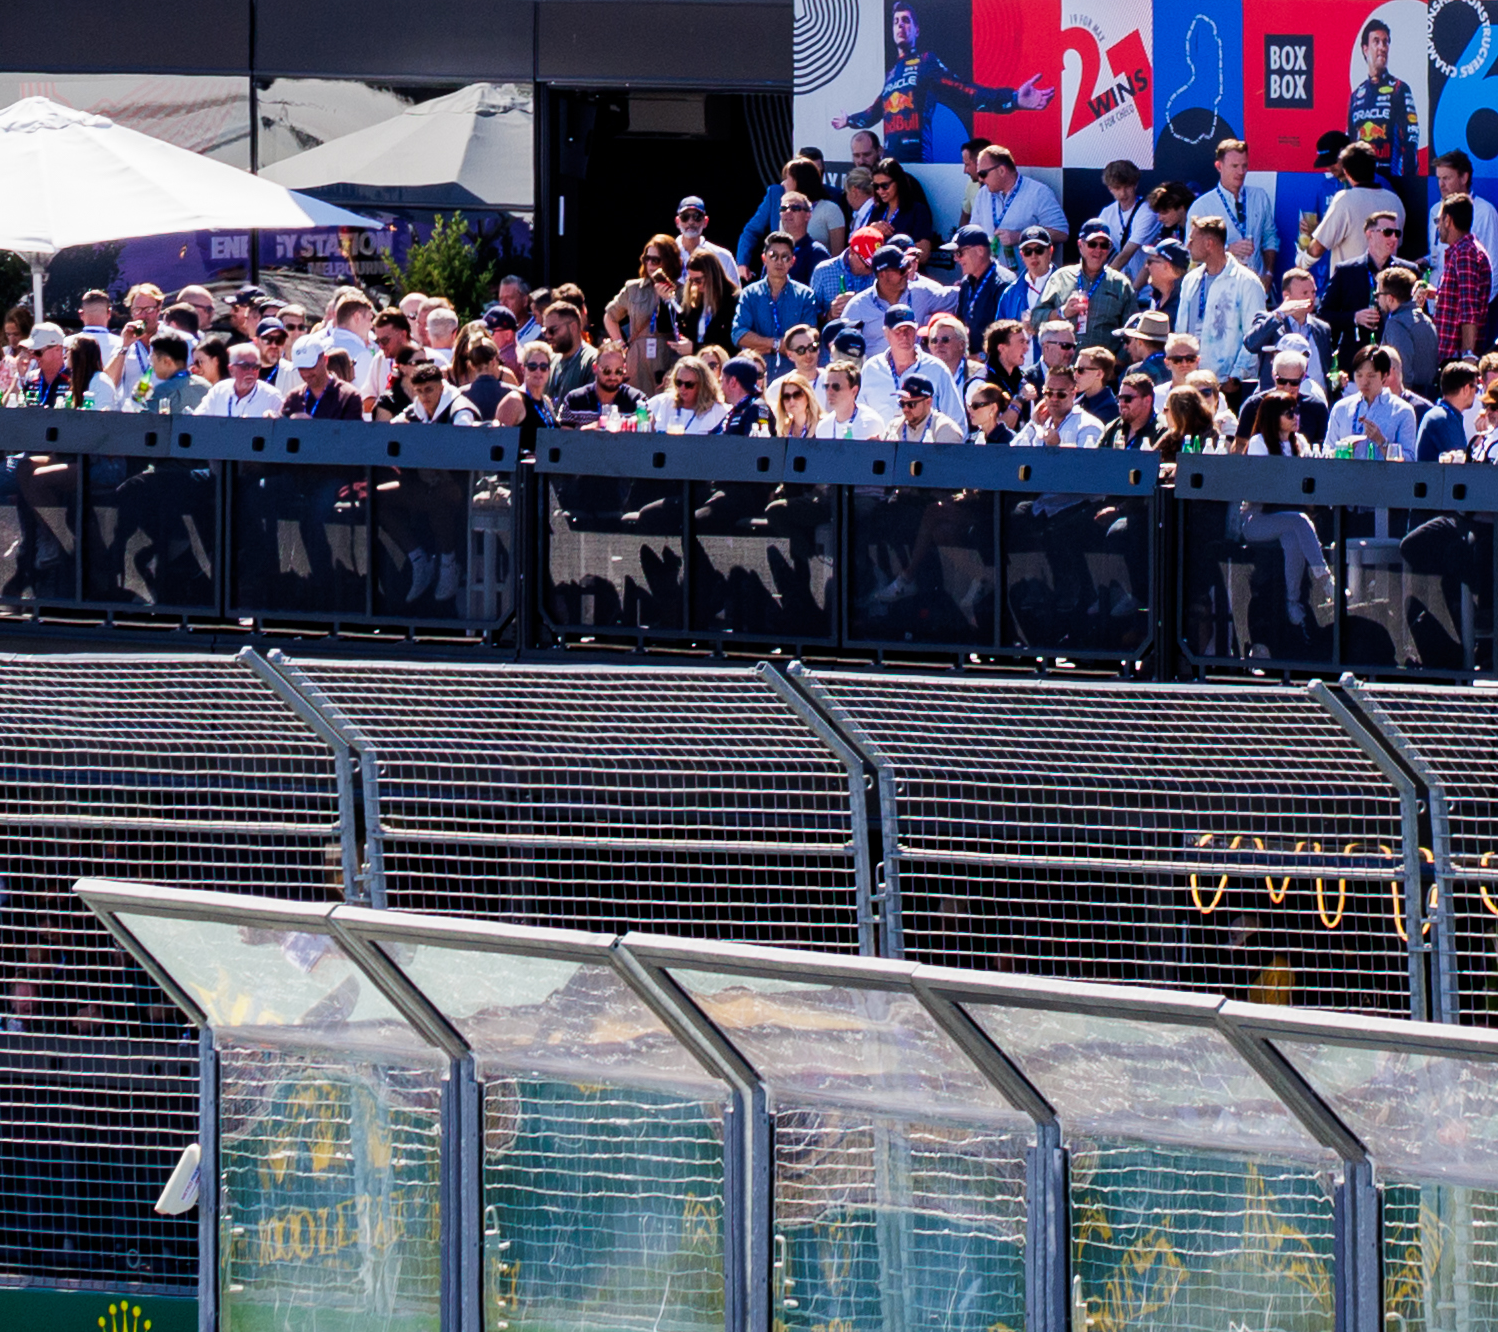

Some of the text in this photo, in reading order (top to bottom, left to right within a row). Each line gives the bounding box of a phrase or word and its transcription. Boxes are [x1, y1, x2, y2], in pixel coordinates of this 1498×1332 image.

[1270, 45, 1307, 71] BOX
[1087, 68, 1149, 120] WINS
[1270, 74, 1307, 100] BOX
